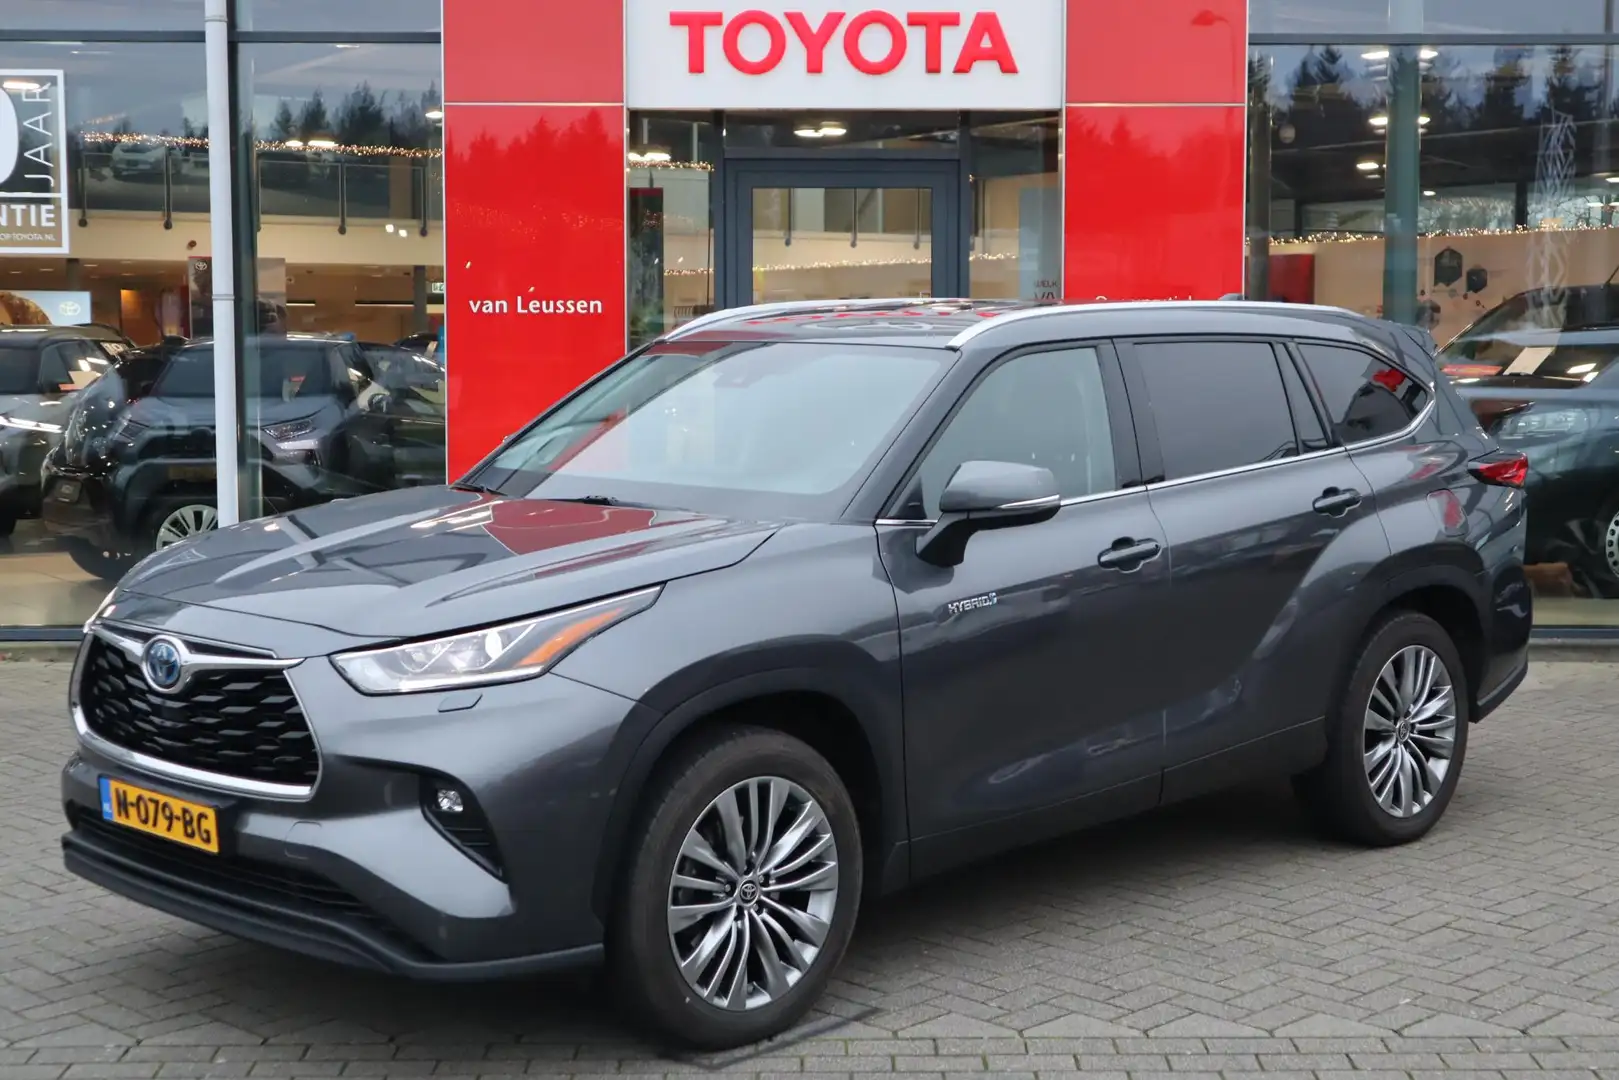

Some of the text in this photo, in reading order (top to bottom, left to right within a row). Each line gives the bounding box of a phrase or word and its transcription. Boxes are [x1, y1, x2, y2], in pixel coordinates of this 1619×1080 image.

[669, 10, 1019, 75] TOYOTA
[22, 82, 54, 187] JAAR
[469, 296, 602, 314] van Leussen
[947, 595, 991, 615] HYBRID
[115, 787, 212, 845] N-079-BG
